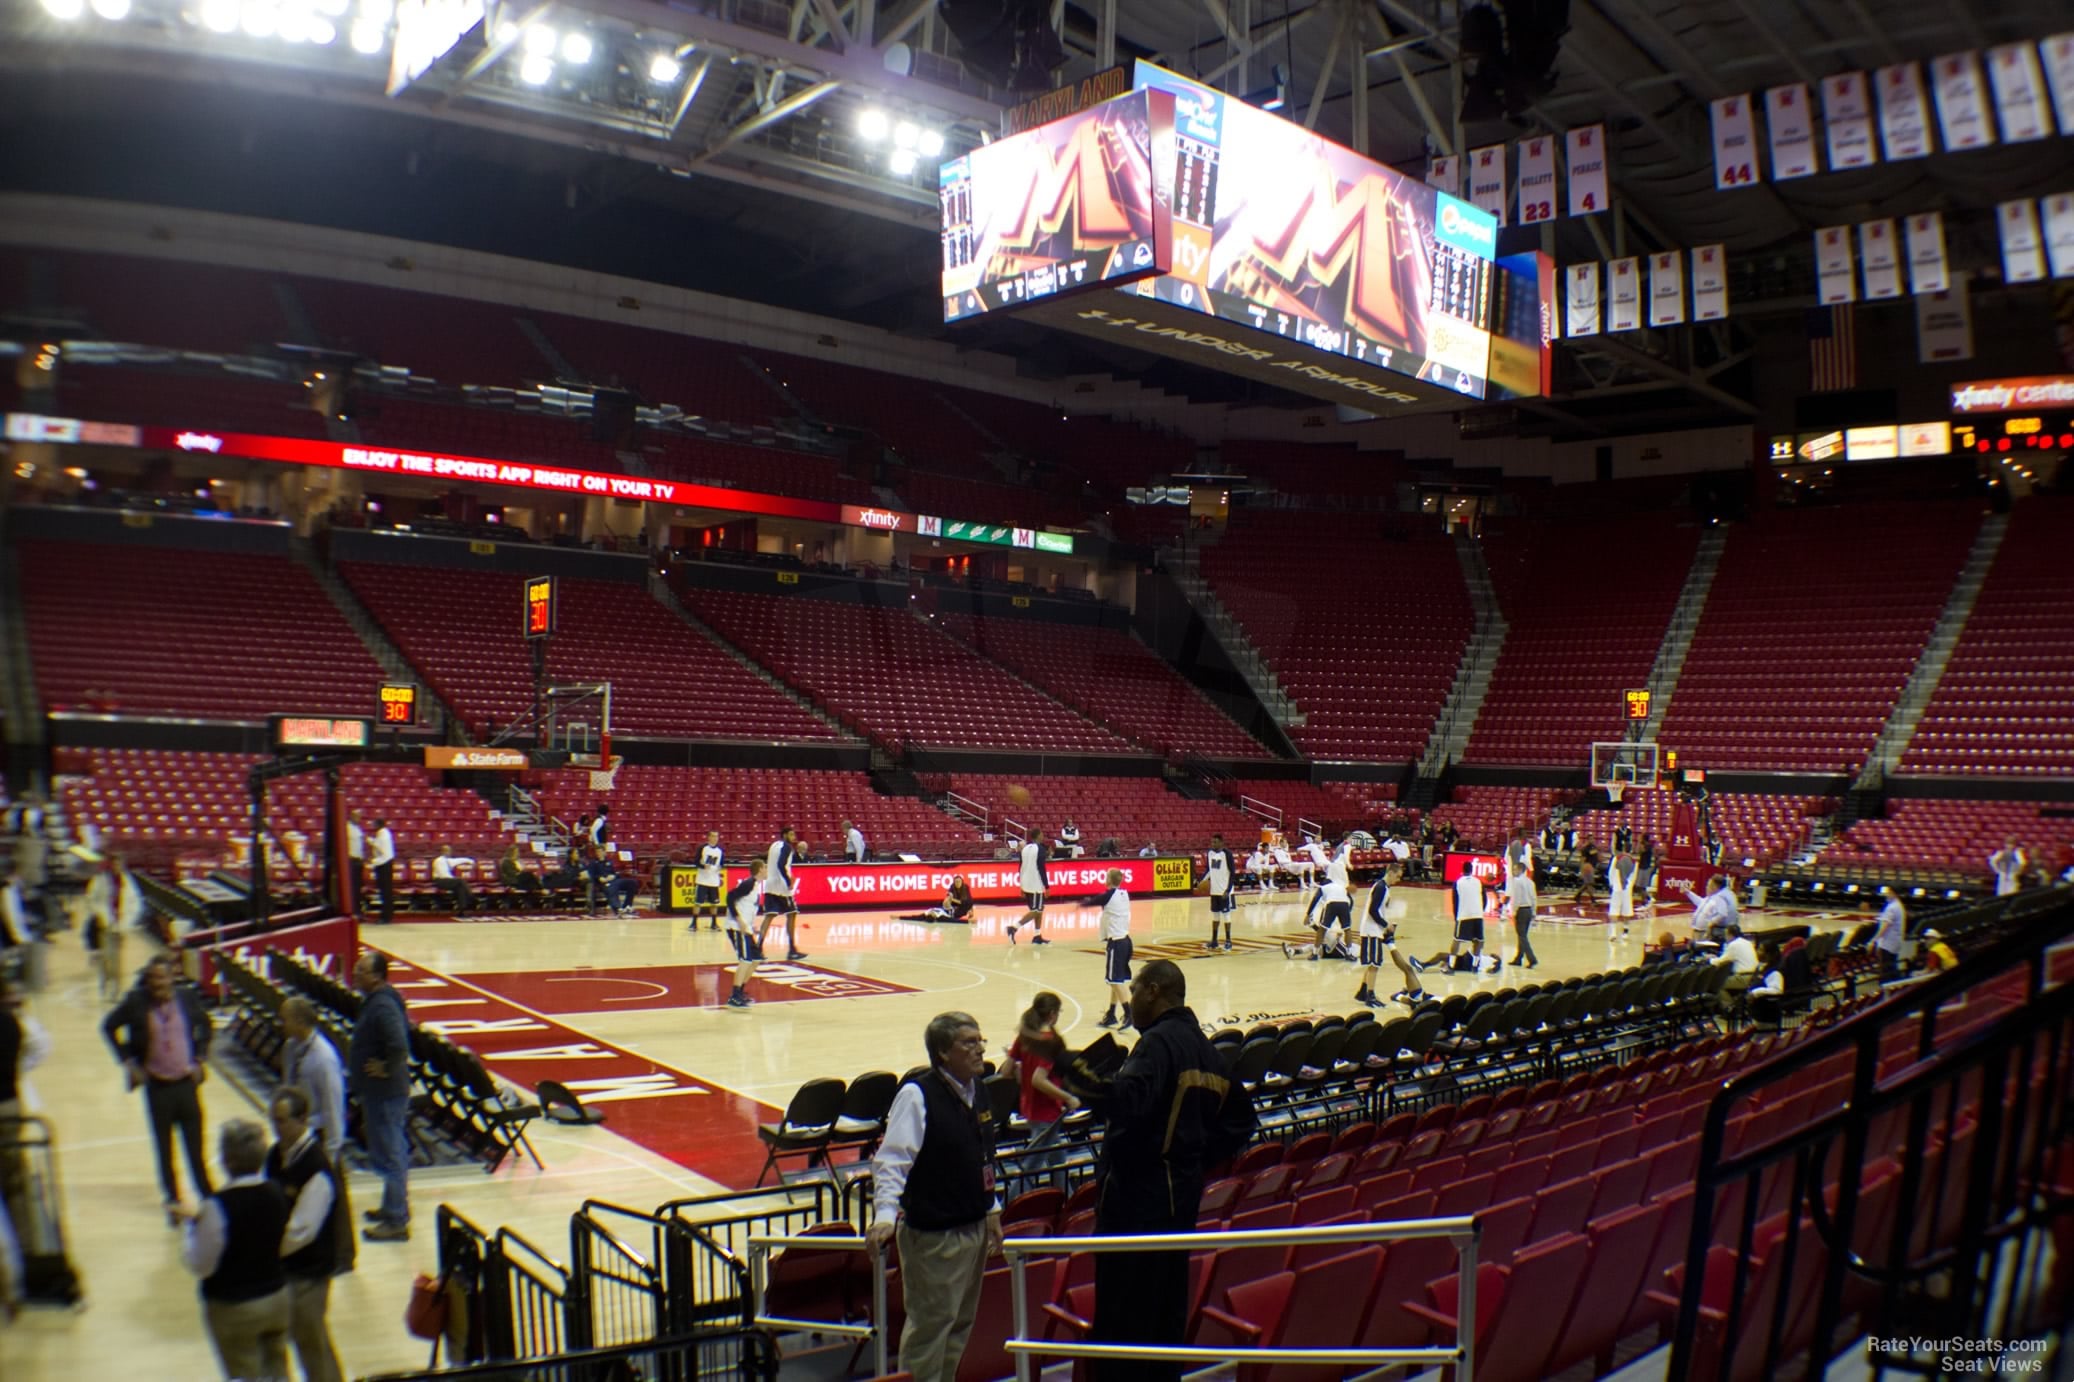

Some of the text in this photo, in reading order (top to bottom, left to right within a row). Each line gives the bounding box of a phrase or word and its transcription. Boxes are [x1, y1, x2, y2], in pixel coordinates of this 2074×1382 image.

[1009, 66, 1125, 133] MARYLAND
[1723, 164, 1752, 184] 44
[1525, 201, 1550, 221] 23
[1582, 192, 1595, 210] 4
[1136, 322, 1273, 360] UNDER
[1269, 361, 1418, 403] ARMOUR
[1952, 380, 2074, 410] xfinity cente
[343, 449, 674, 499] ENJOY THE SPORTS APP RIGHT ON YOUR TV
[859, 509, 900, 529] xfinity
[385, 703, 405, 720] 30
[1630, 701, 1647, 717] 30
[827, 876, 876, 893] YOUR
[880, 874, 928, 891] HOME
[968, 872, 998, 888] THE
[1046, 870, 1077, 886] LIVE
